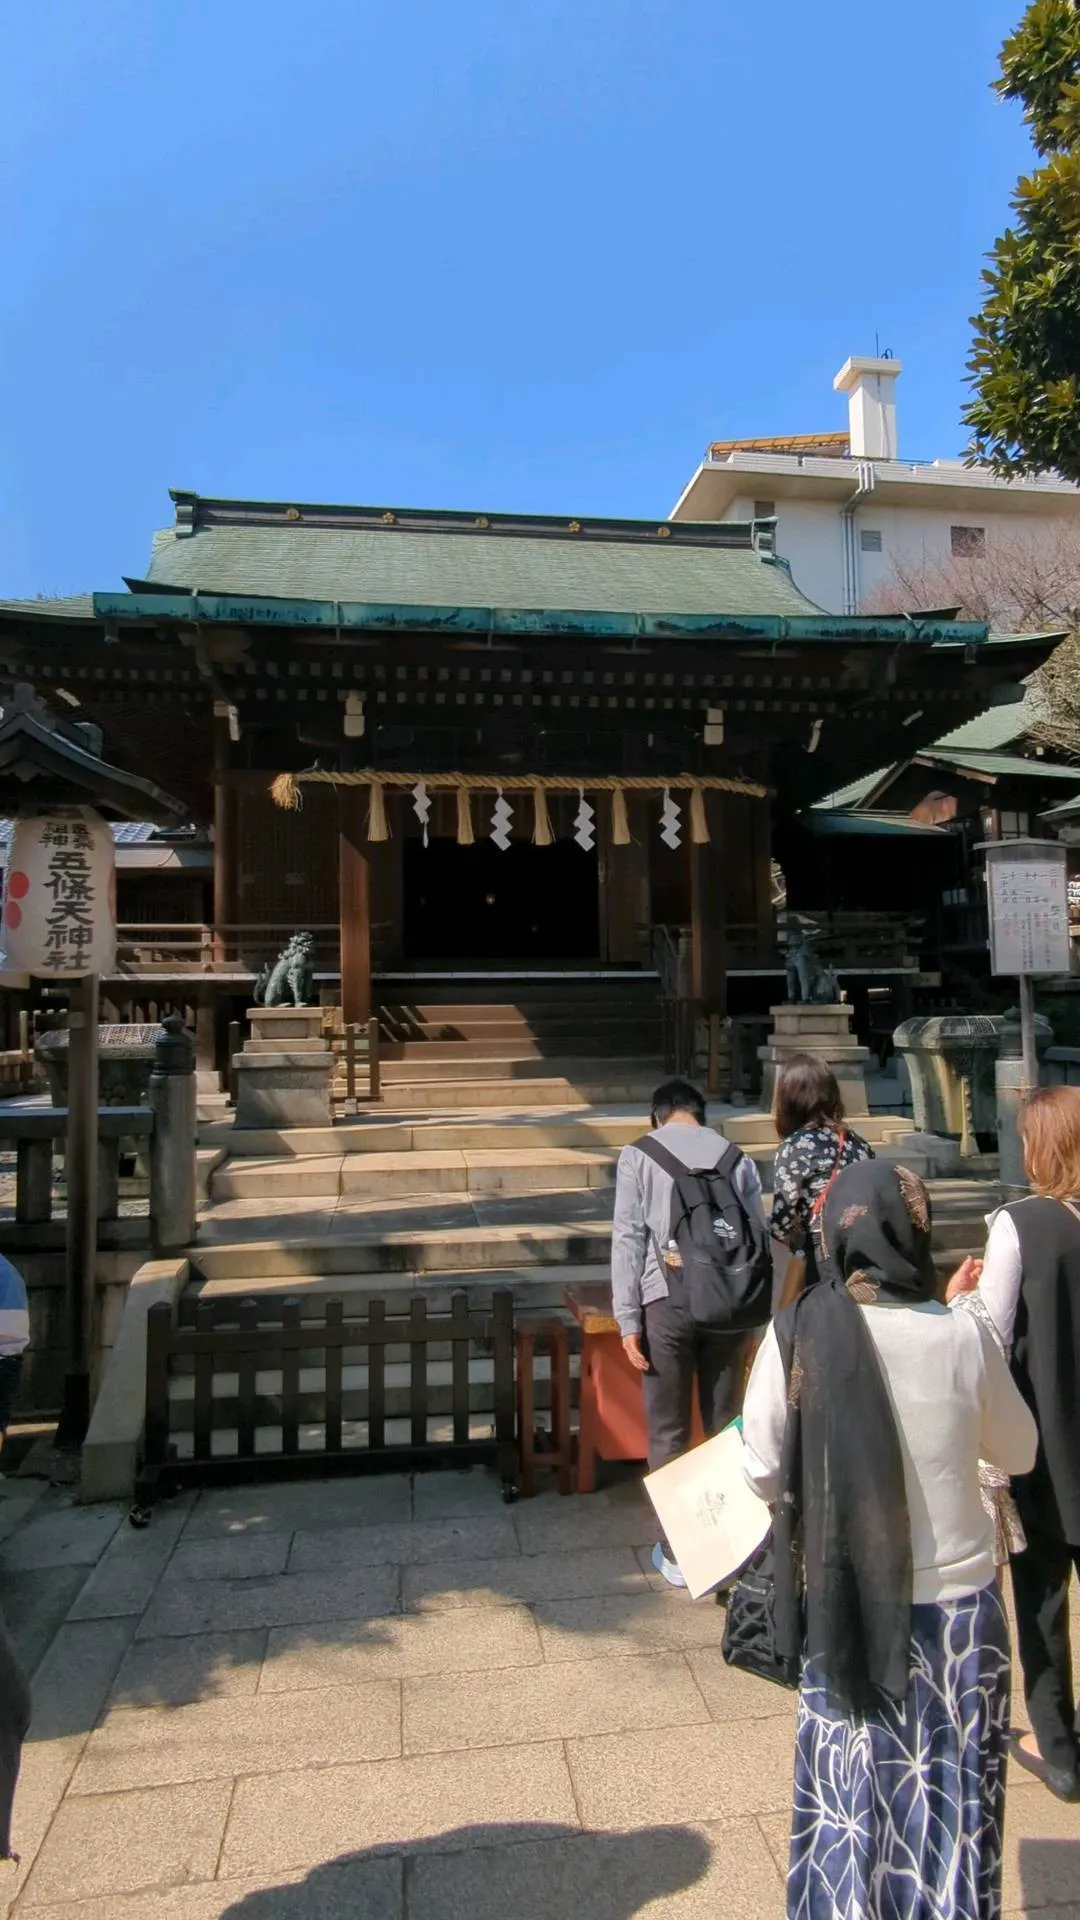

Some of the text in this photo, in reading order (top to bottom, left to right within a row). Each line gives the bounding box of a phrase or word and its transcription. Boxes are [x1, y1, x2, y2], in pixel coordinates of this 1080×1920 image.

[38, 822, 69, 848] 祖神
[42, 851, 96, 972] 五條天神社
